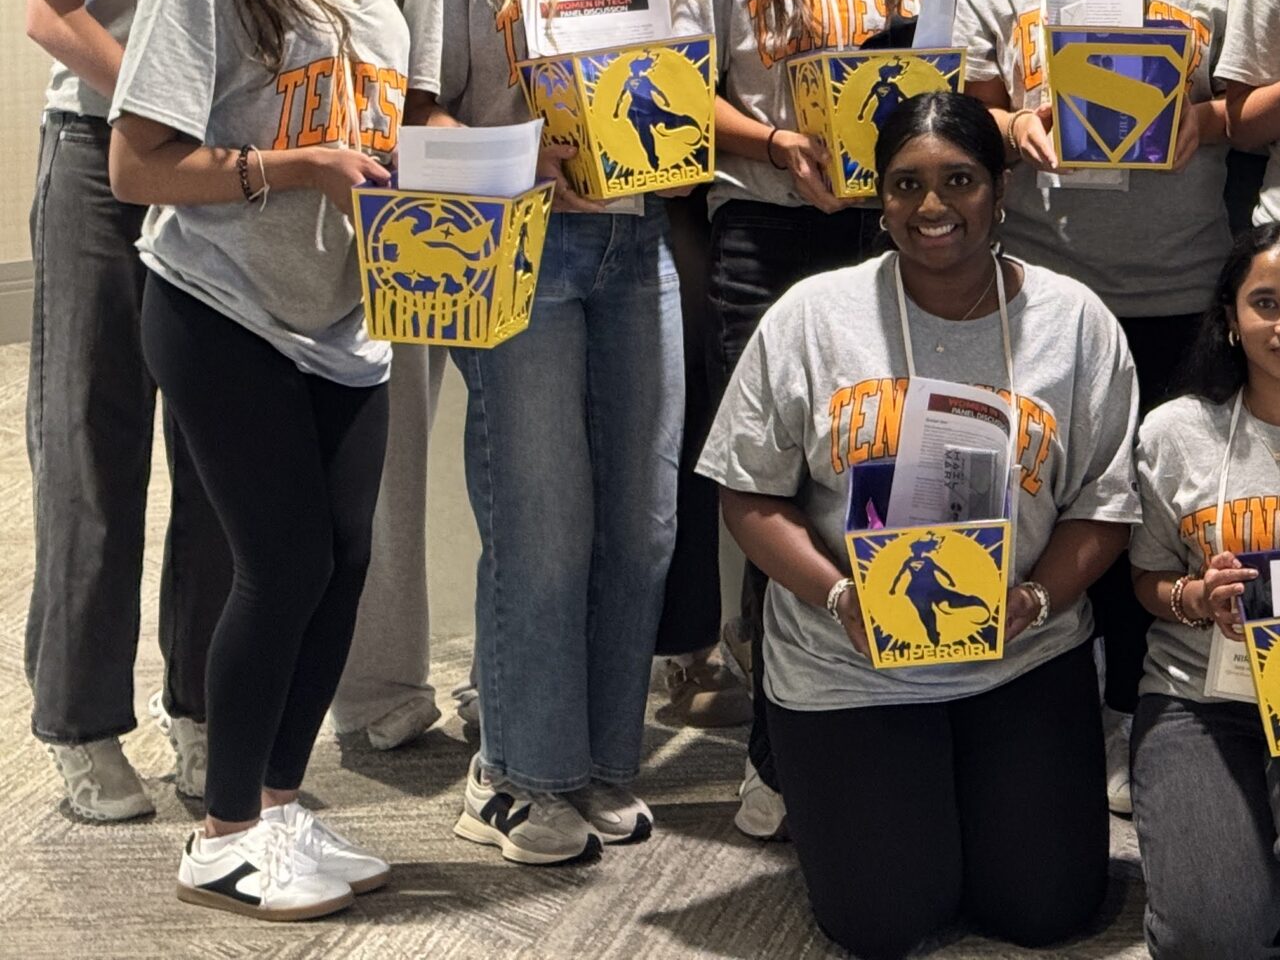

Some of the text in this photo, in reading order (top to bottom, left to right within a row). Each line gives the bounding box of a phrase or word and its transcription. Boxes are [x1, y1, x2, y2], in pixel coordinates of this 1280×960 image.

[557, 0, 593, 10] WOMEN
[560, 5, 628, 18] PANEL DISCUSSION
[607, 166, 709, 192] SUPERGIRL
[374, 286, 493, 340] KRYPTO
[949, 398, 986, 414] WOMEN
[952, 407, 975, 418] PANEL
[944, 450, 952, 488] MARY
[881, 643, 1000, 662] SUPERGIRL
